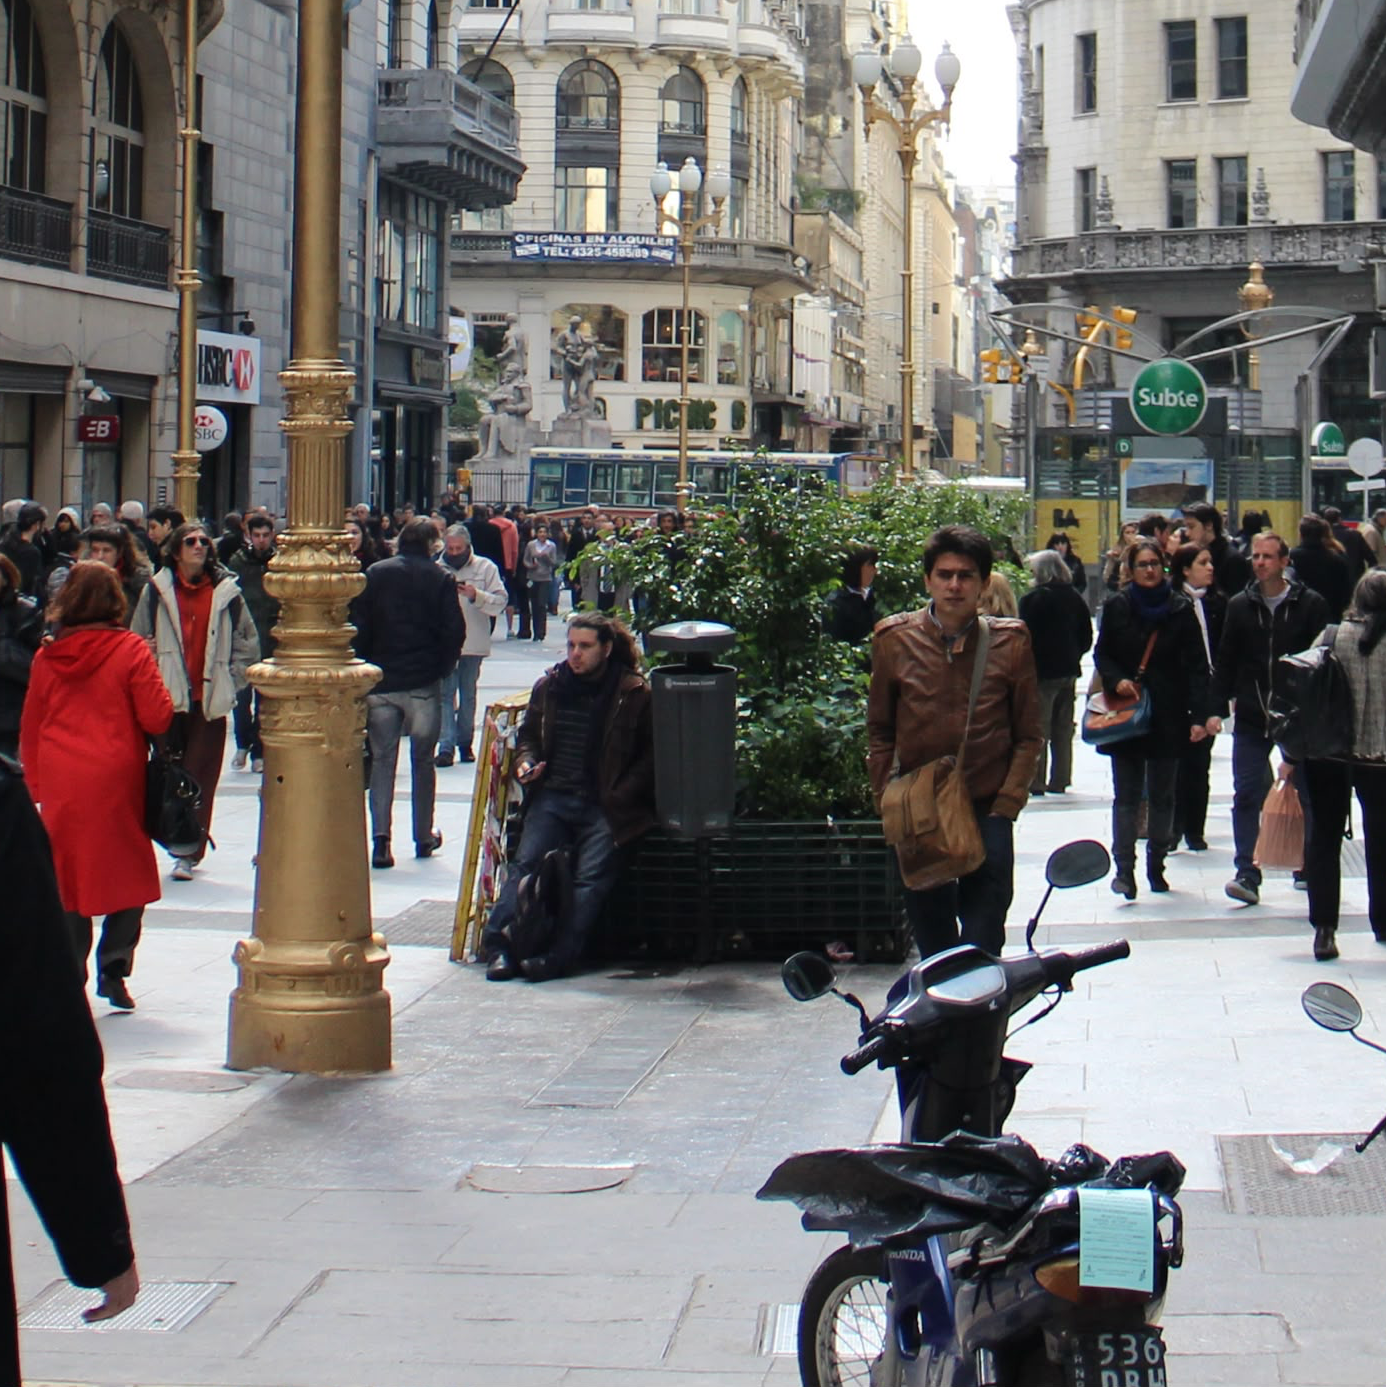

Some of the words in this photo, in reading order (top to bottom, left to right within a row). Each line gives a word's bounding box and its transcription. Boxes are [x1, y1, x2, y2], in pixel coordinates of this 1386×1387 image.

[515, 234, 582, 244] OFICINAS
[585, 234, 605, 244] EN
[608, 234, 674, 247] ALQUILER
[542, 246, 569, 257] TEL:
[198, 343, 233, 388] HSBC
[1138, 387, 1199, 408] Subte
[195, 428, 223, 441] SBC
[1120, 442, 1129, 453] D
[1098, 1334, 1160, 1365] 536
